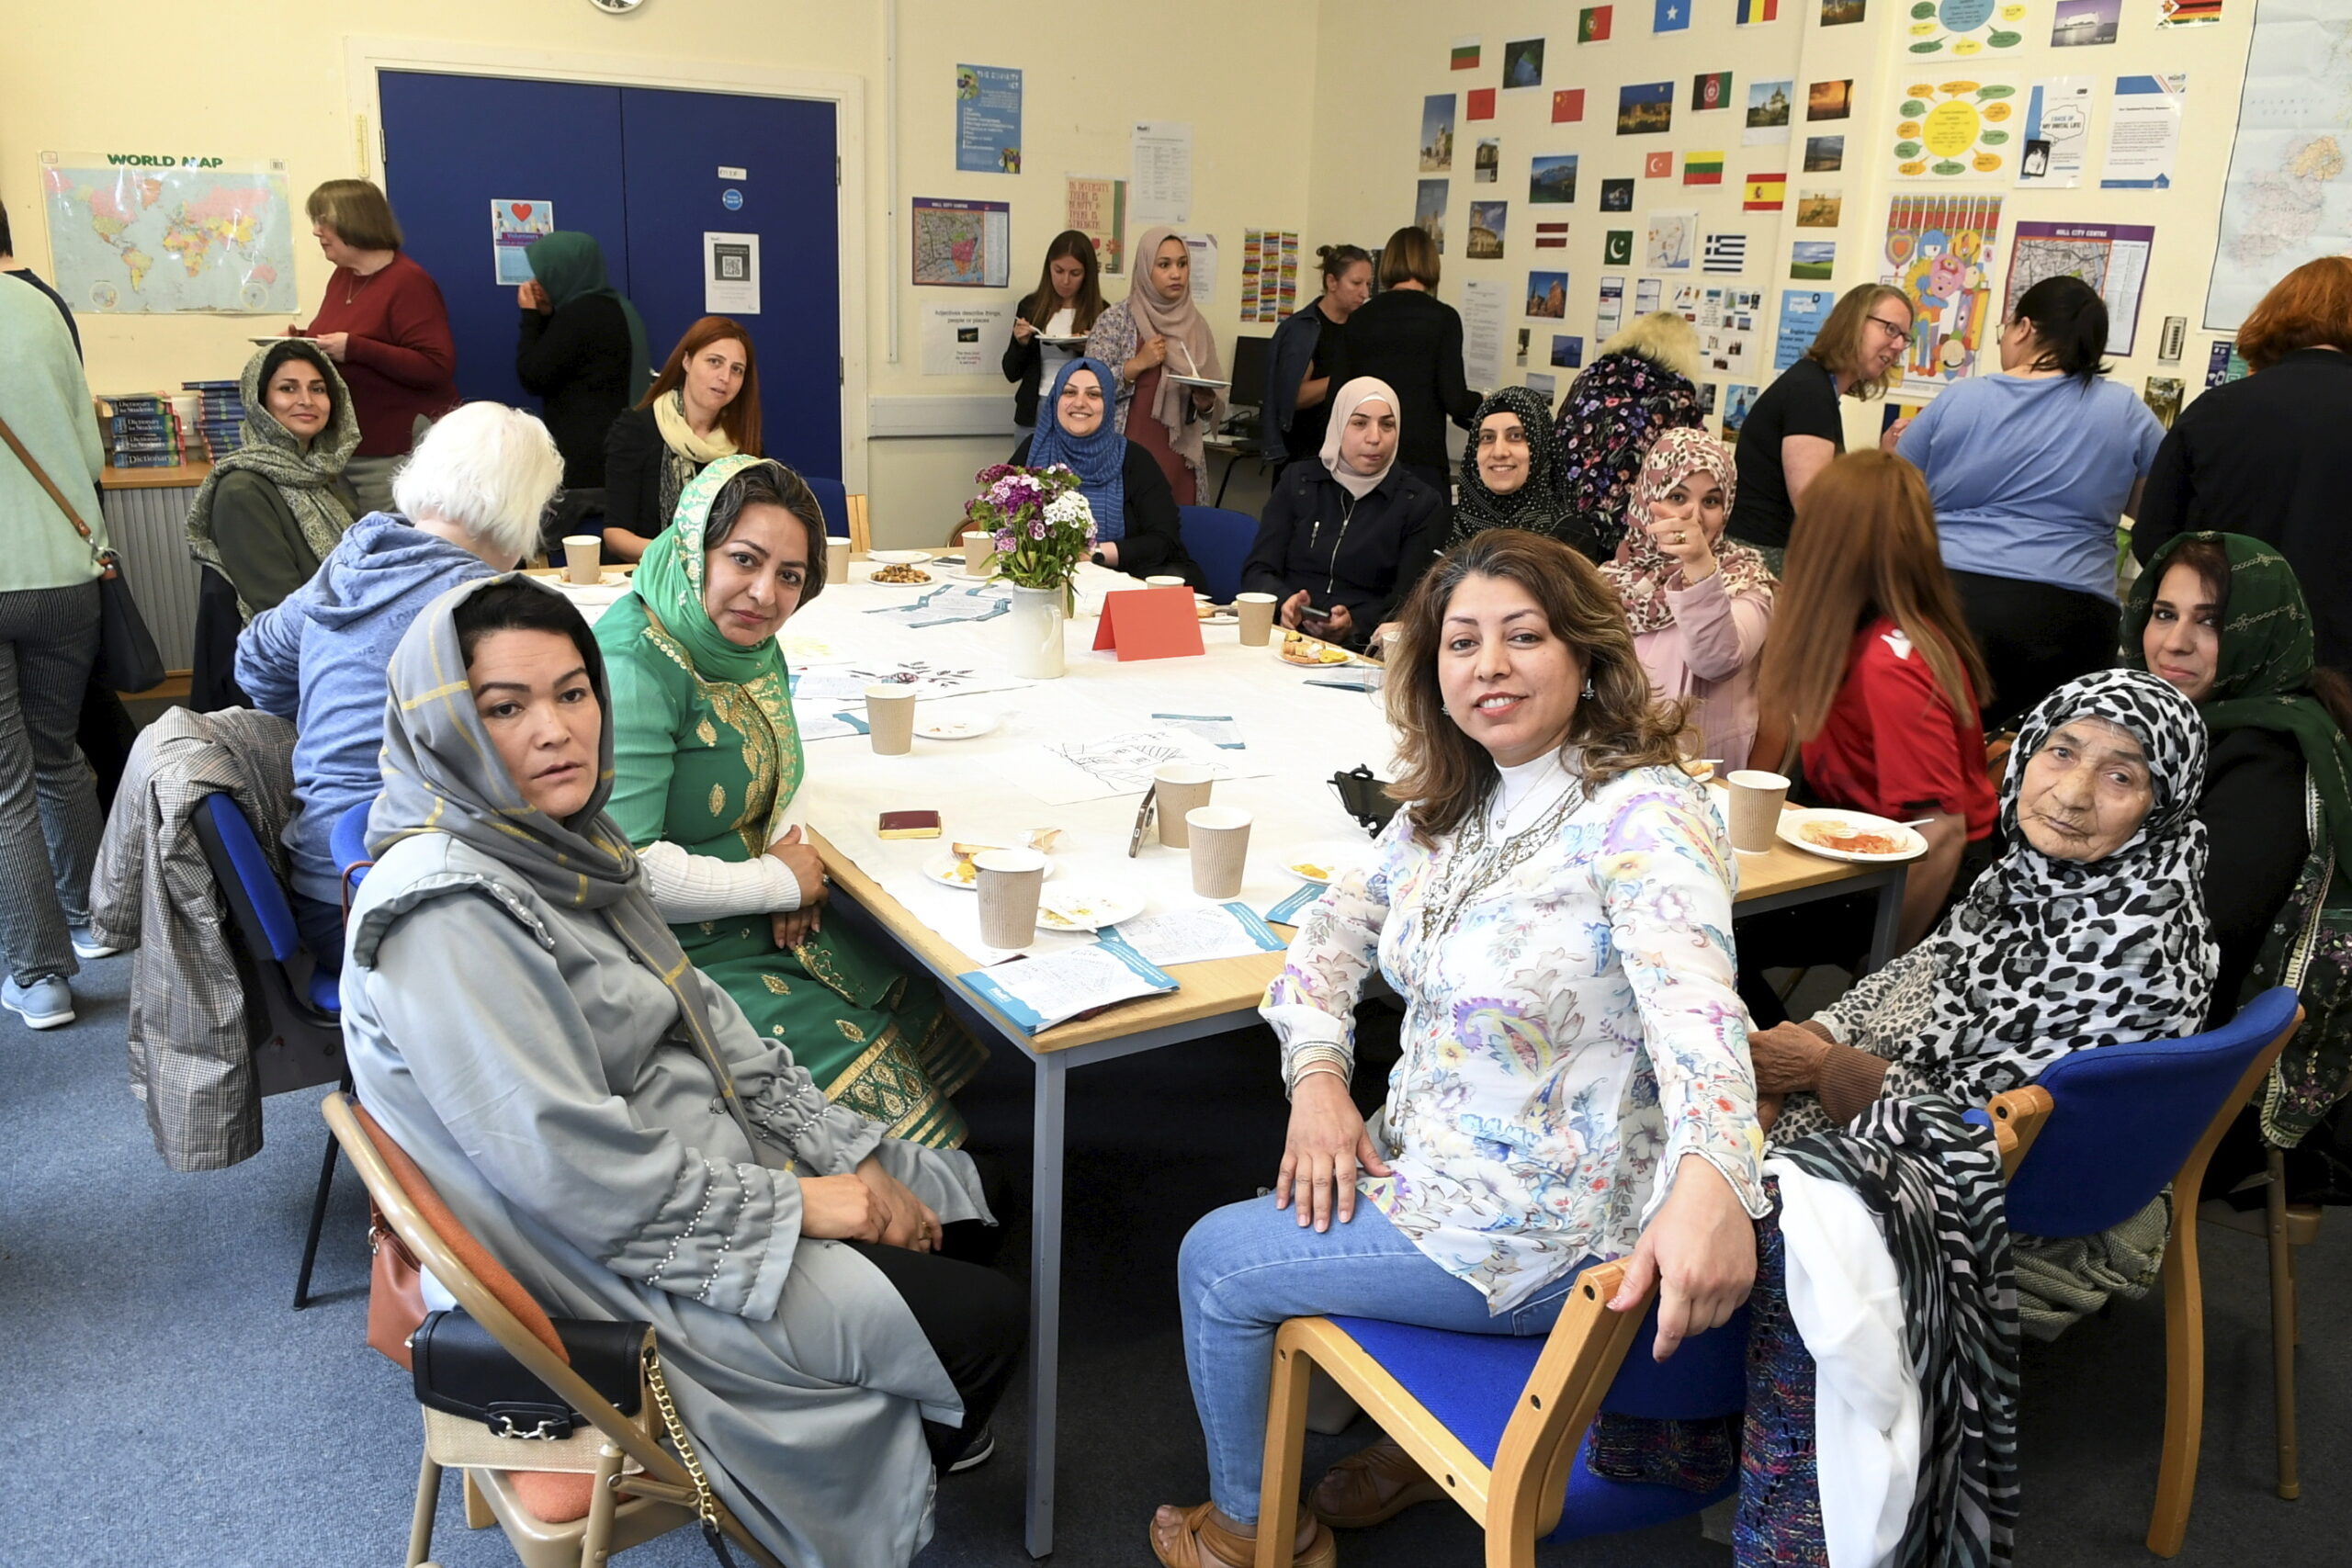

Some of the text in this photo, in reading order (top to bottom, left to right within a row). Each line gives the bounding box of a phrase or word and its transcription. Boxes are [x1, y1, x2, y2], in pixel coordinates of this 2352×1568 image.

[107, 153, 223, 168] WORLD MAP
[129, 454, 171, 465] Dictionary
